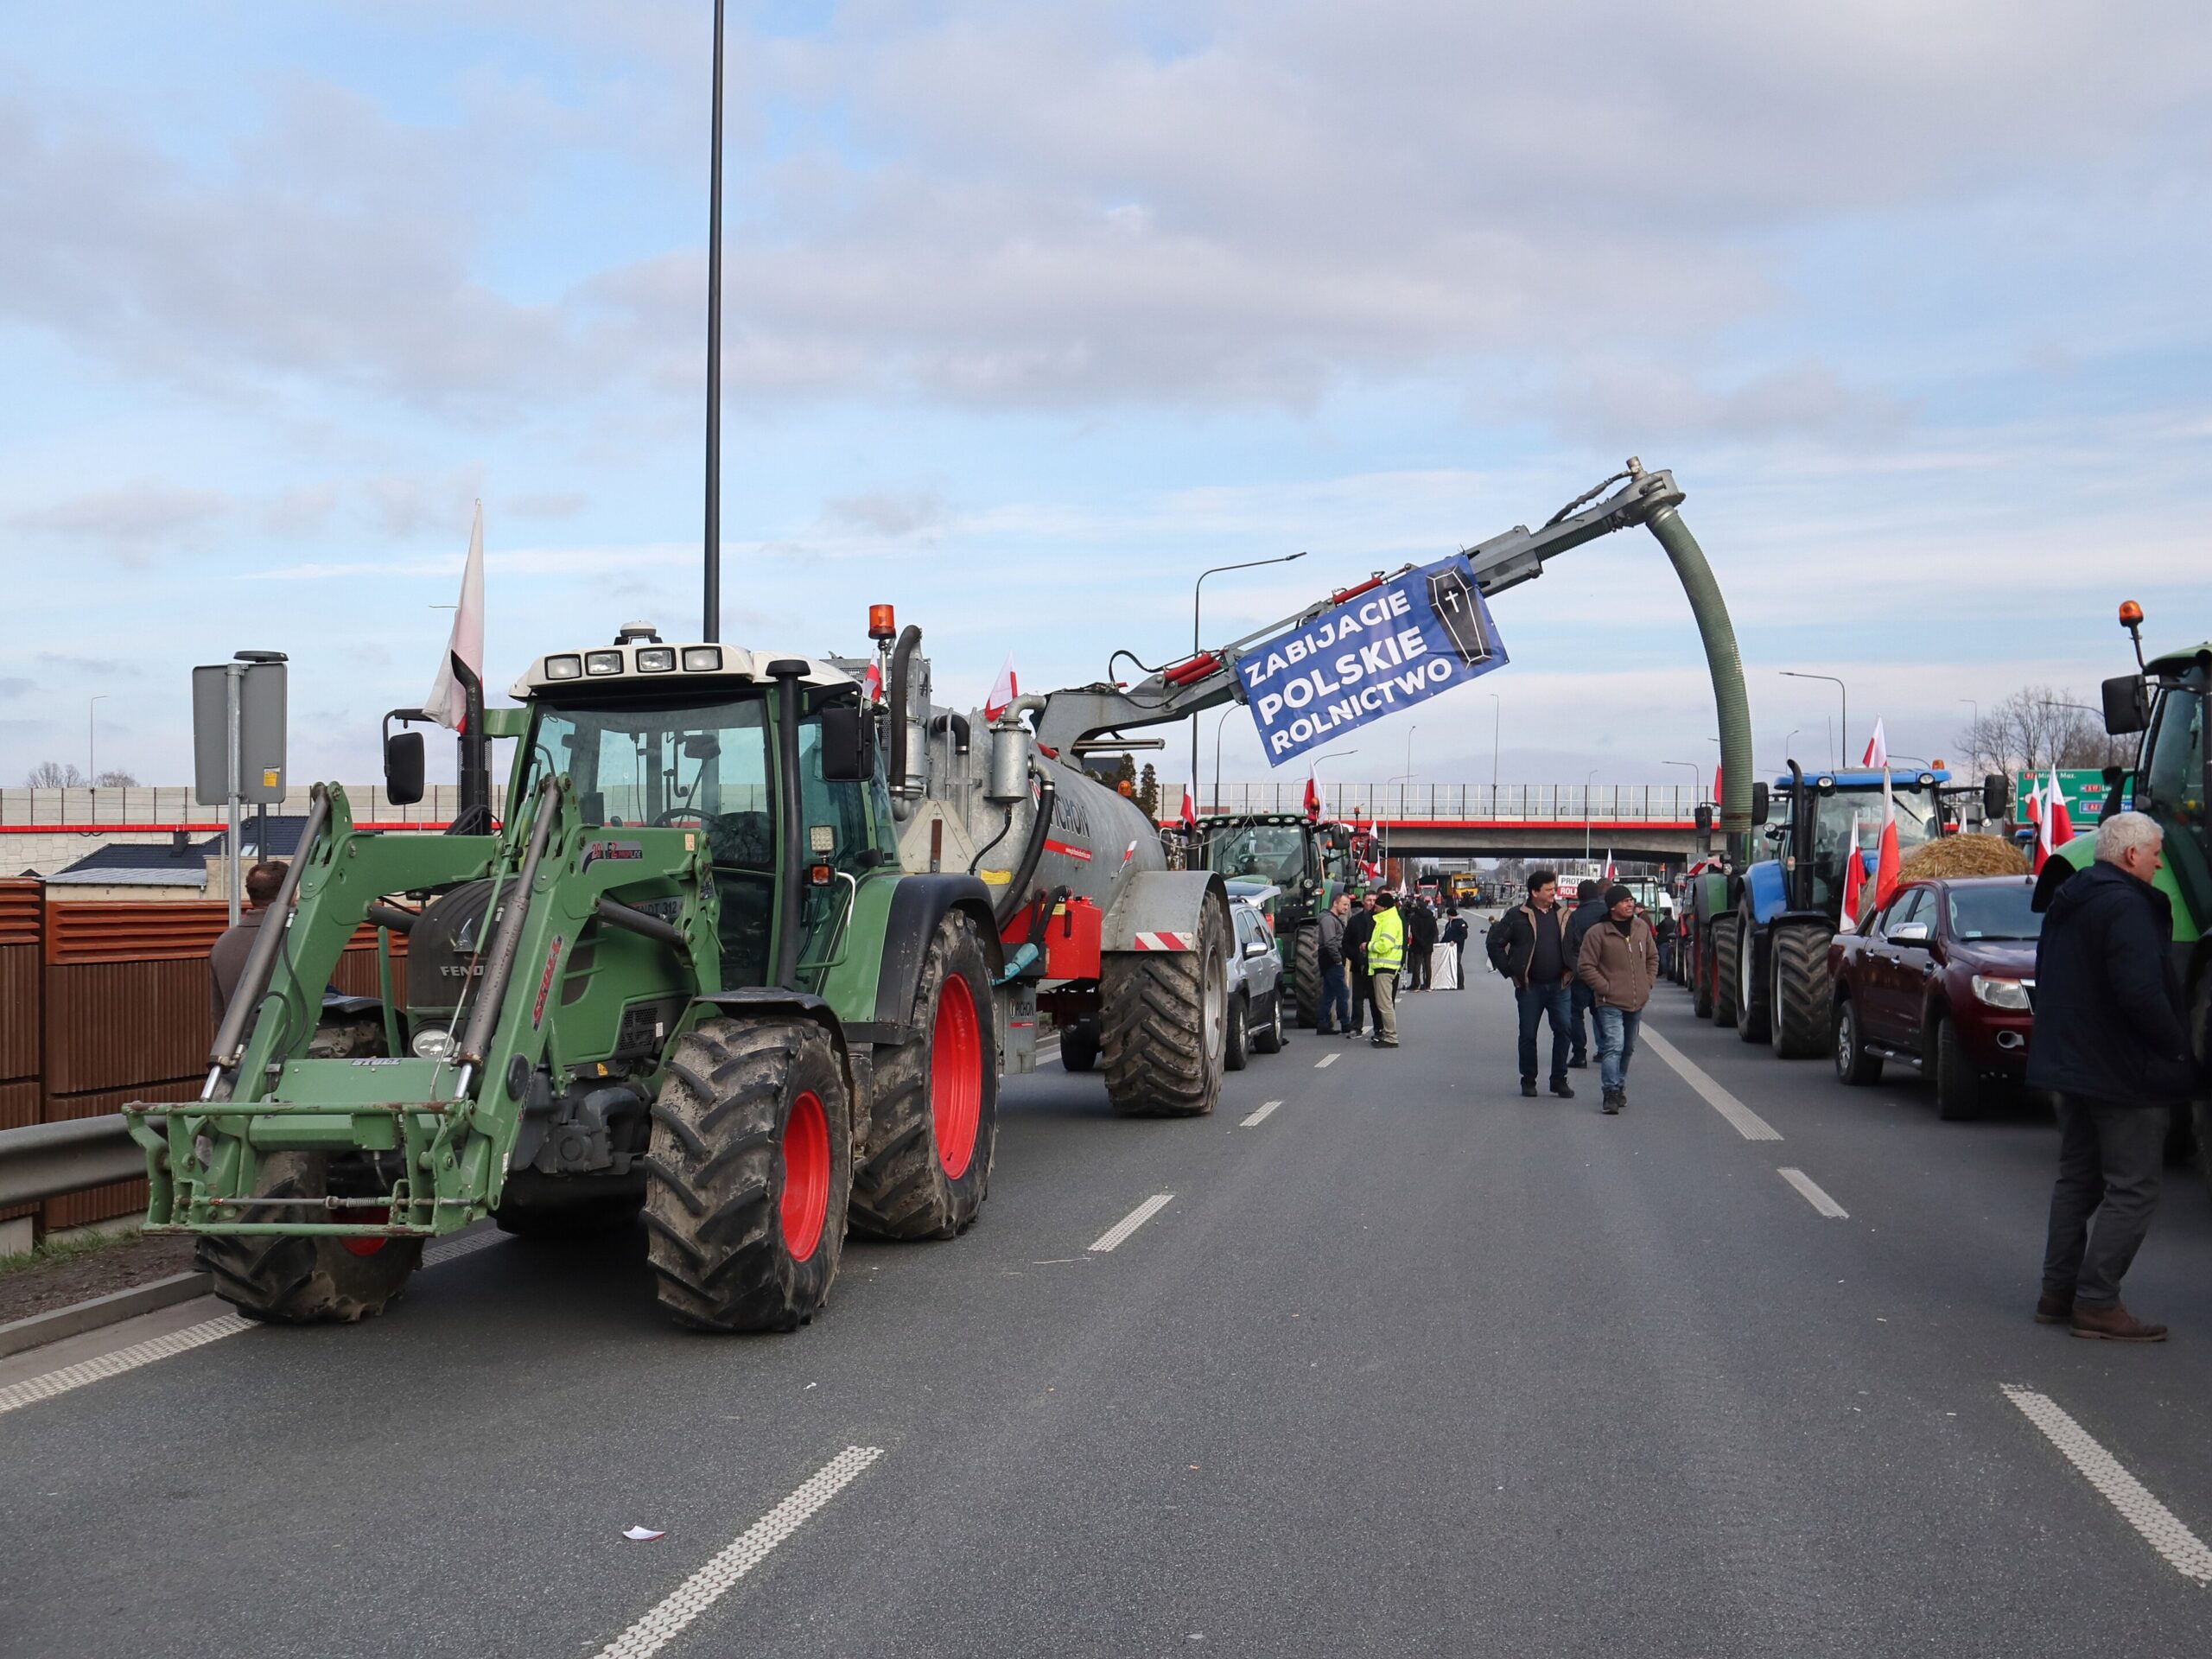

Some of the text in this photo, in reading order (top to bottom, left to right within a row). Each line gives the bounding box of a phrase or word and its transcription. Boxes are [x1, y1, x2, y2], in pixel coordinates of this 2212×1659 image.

[1244, 589, 1411, 689] ZABIJACIE
[1258, 626, 1428, 726] POLSKIE
[1270, 658, 1452, 755] ROLNICTWO
[1050, 793, 1090, 839] ICHON
[663, 900, 677, 914] 312
[439, 965, 484, 976] FEND
